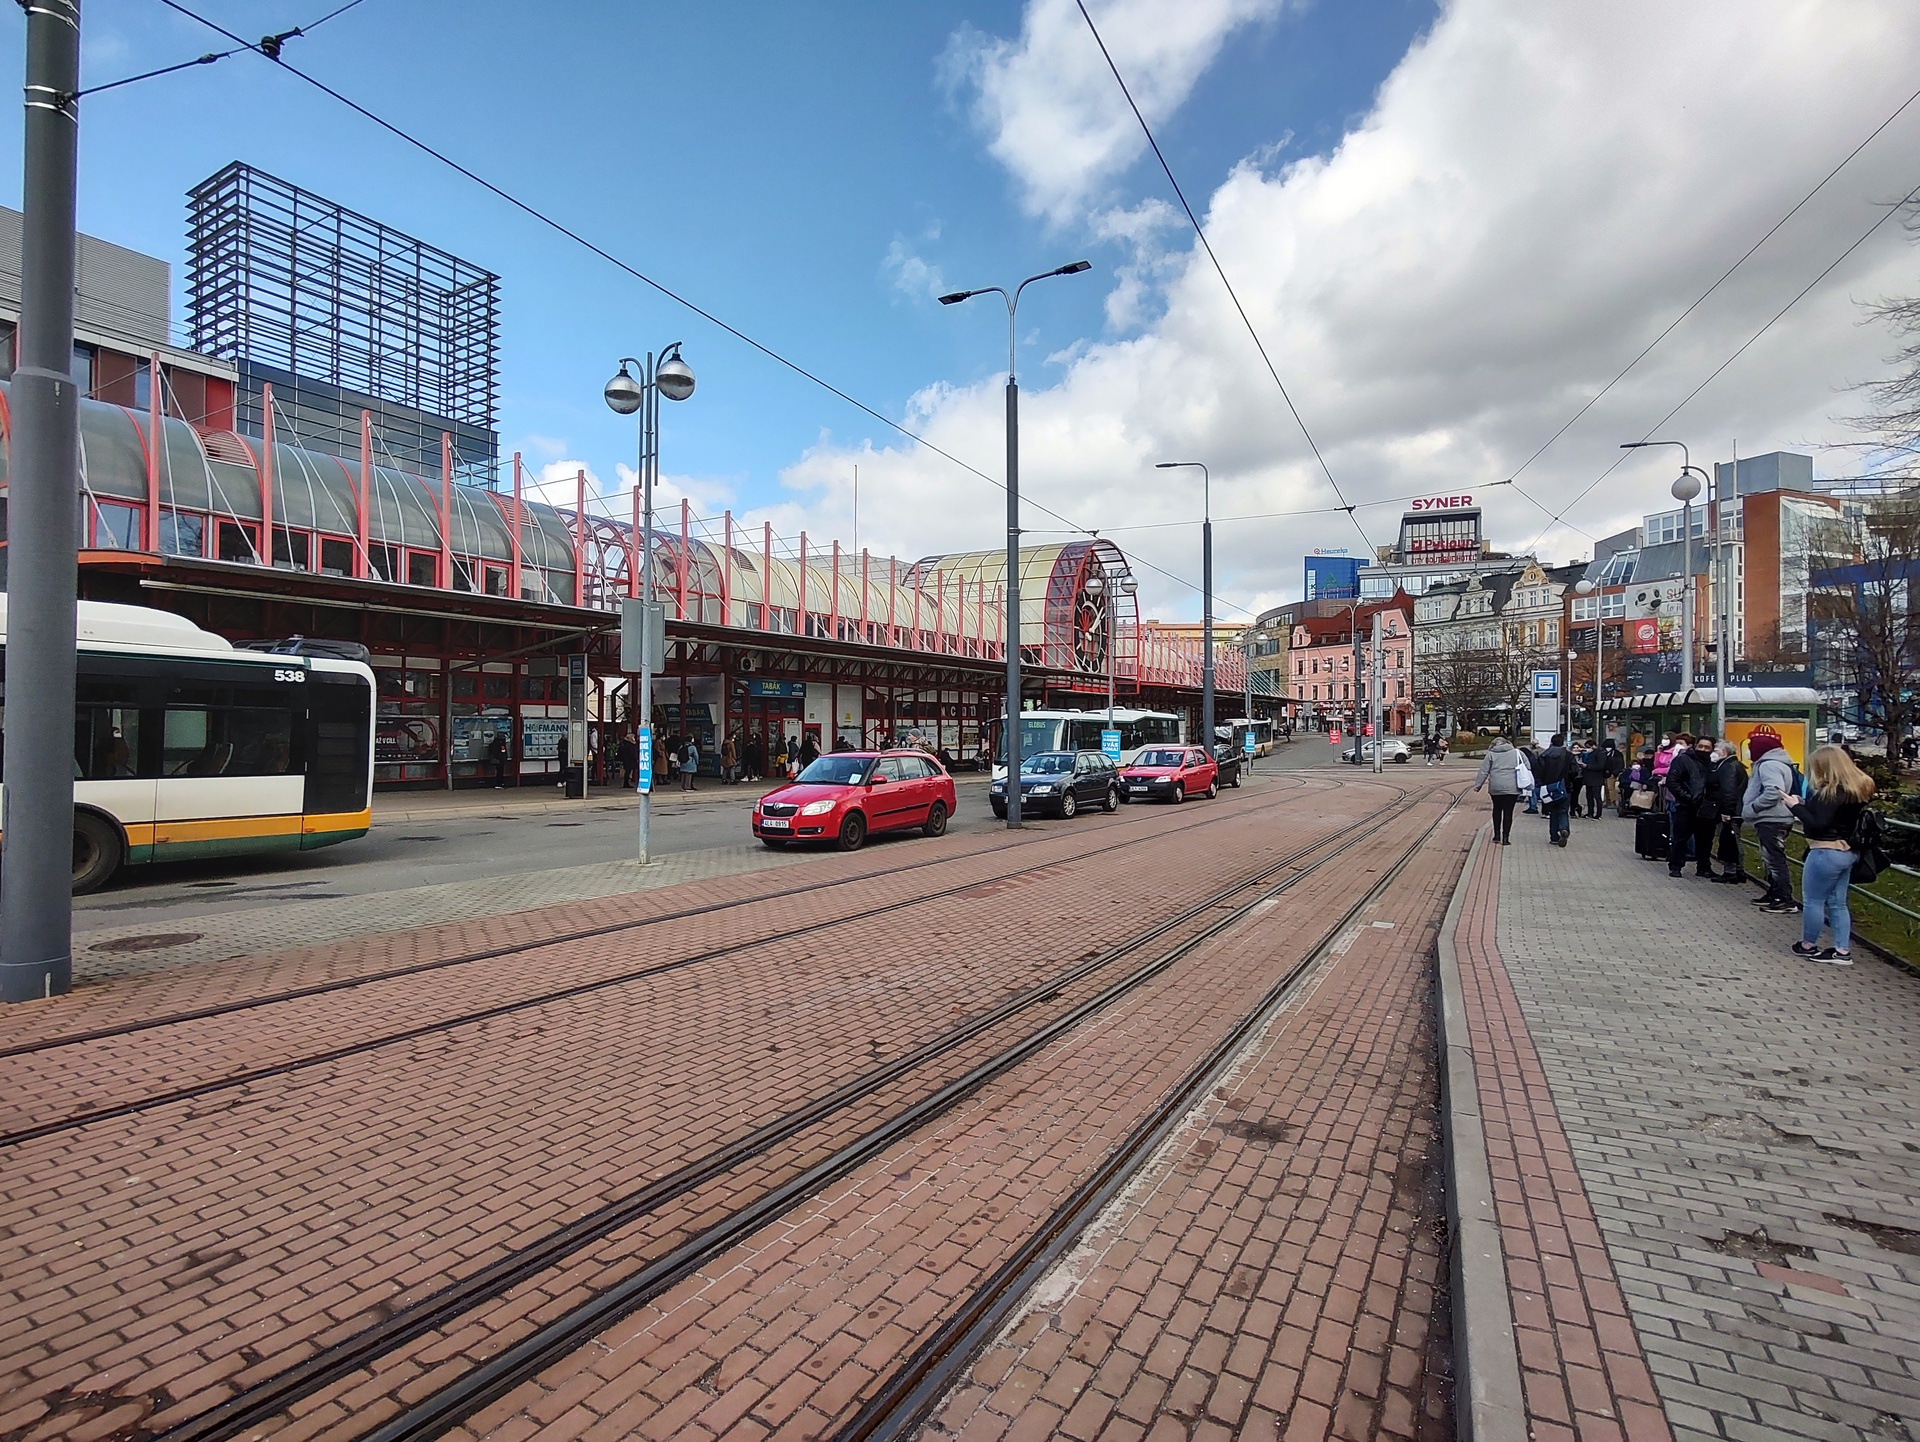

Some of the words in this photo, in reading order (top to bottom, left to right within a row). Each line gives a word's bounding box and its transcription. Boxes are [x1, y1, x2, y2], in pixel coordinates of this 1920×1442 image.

[1411, 495, 1473, 511] SYNER
[1320, 547, 1349, 555] Heureka
[273, 669, 306, 683] 538
[1730, 674, 1753, 682] PLAC
[761, 681, 781, 690] TABÁK
[525, 723, 569, 733] HOFMANN
